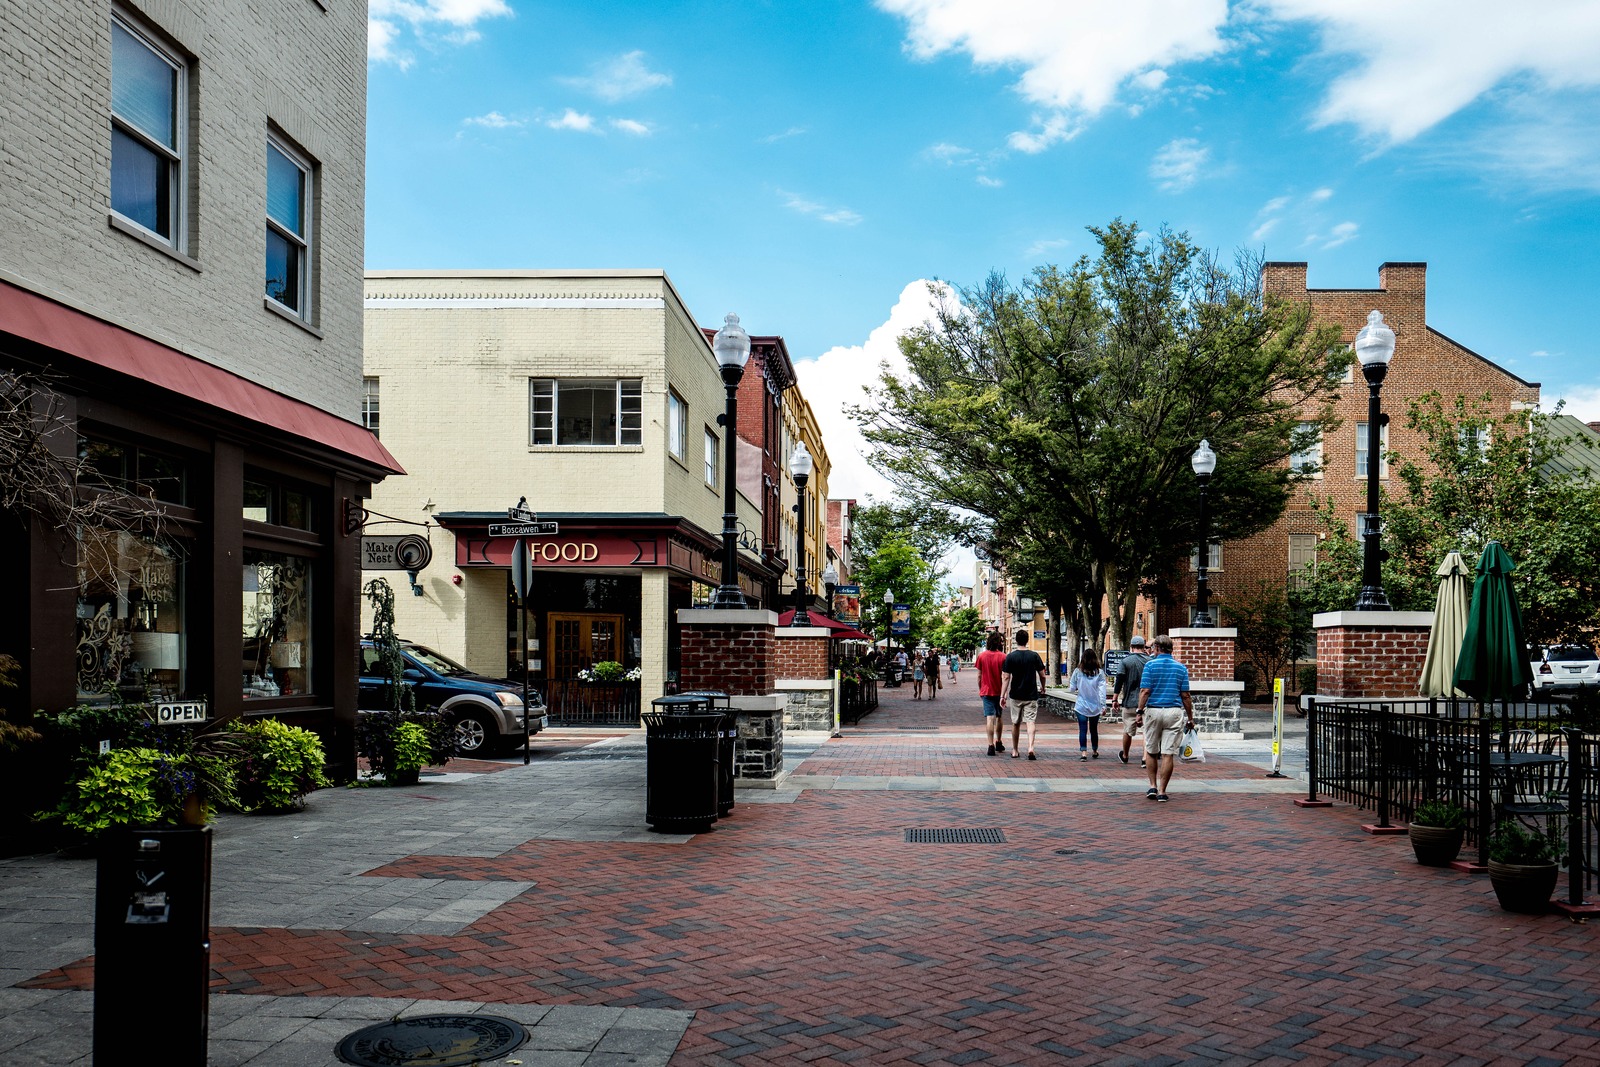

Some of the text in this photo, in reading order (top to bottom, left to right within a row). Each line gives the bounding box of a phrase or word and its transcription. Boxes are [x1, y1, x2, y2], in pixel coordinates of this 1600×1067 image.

[501, 525, 539, 534] Boscawen
[365, 542, 394, 553] Make
[531, 542, 598, 561] FOOD
[367, 553, 392, 563] Nest
[138, 566, 170, 585] Make
[141, 584, 168, 602] Nest
[160, 705, 204, 721] OPEN
